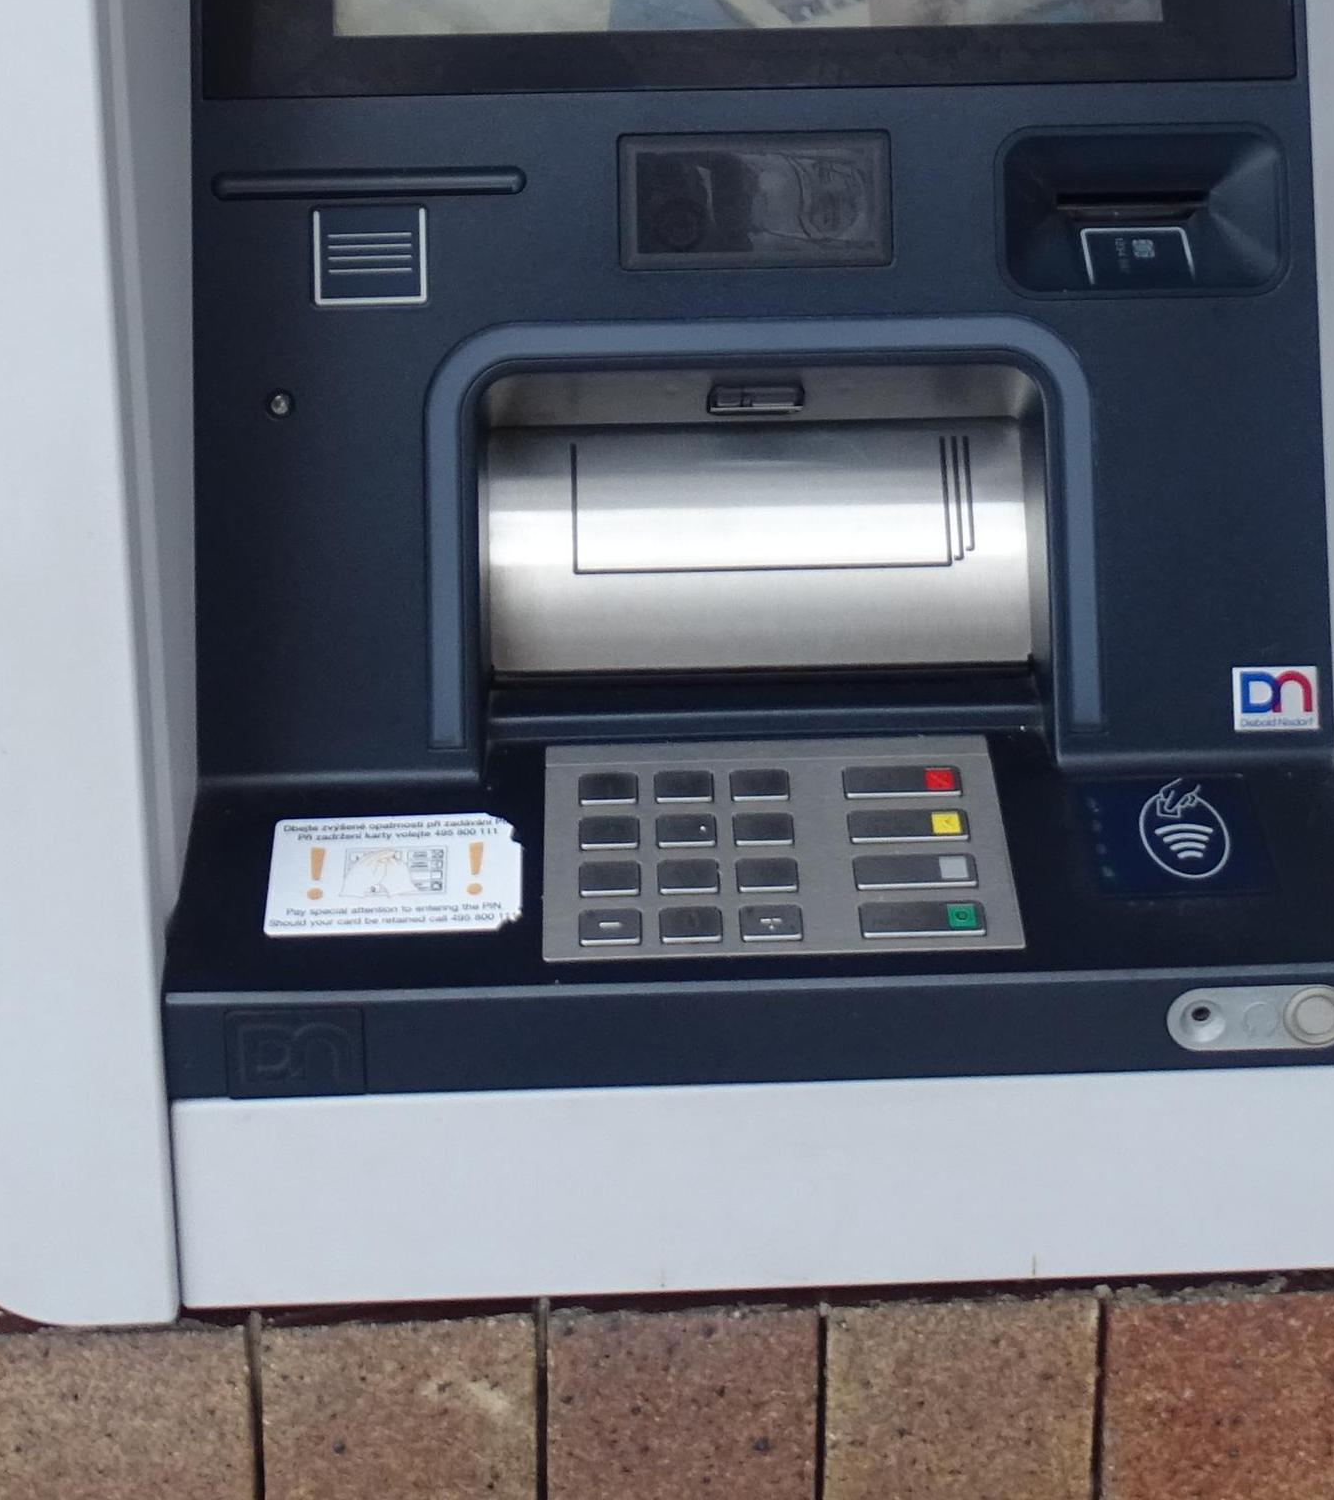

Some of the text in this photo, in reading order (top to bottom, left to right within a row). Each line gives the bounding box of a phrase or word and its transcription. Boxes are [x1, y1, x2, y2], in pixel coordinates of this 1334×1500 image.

[283, 823, 319, 833] Dbejte
[322, 821, 366, 833] zvýšené
[369, 820, 424, 831] opatrnosti
[427, 819, 442, 830] při
[297, 832, 313, 842] Při
[316, 830, 362, 842] zadržení
[365, 830, 392, 841] karty
[395, 828, 431, 840] volejte
[480, 826, 499, 836] 111
[286, 900, 502, 918] Pay special attention to entering the PIN
[268, 917, 307, 928] Should
[309, 917, 334, 928] your
[337, 915, 362, 925] card
[364, 915, 380, 925] be
[382, 913, 427, 924] retained
[429, 913, 449, 923] call
